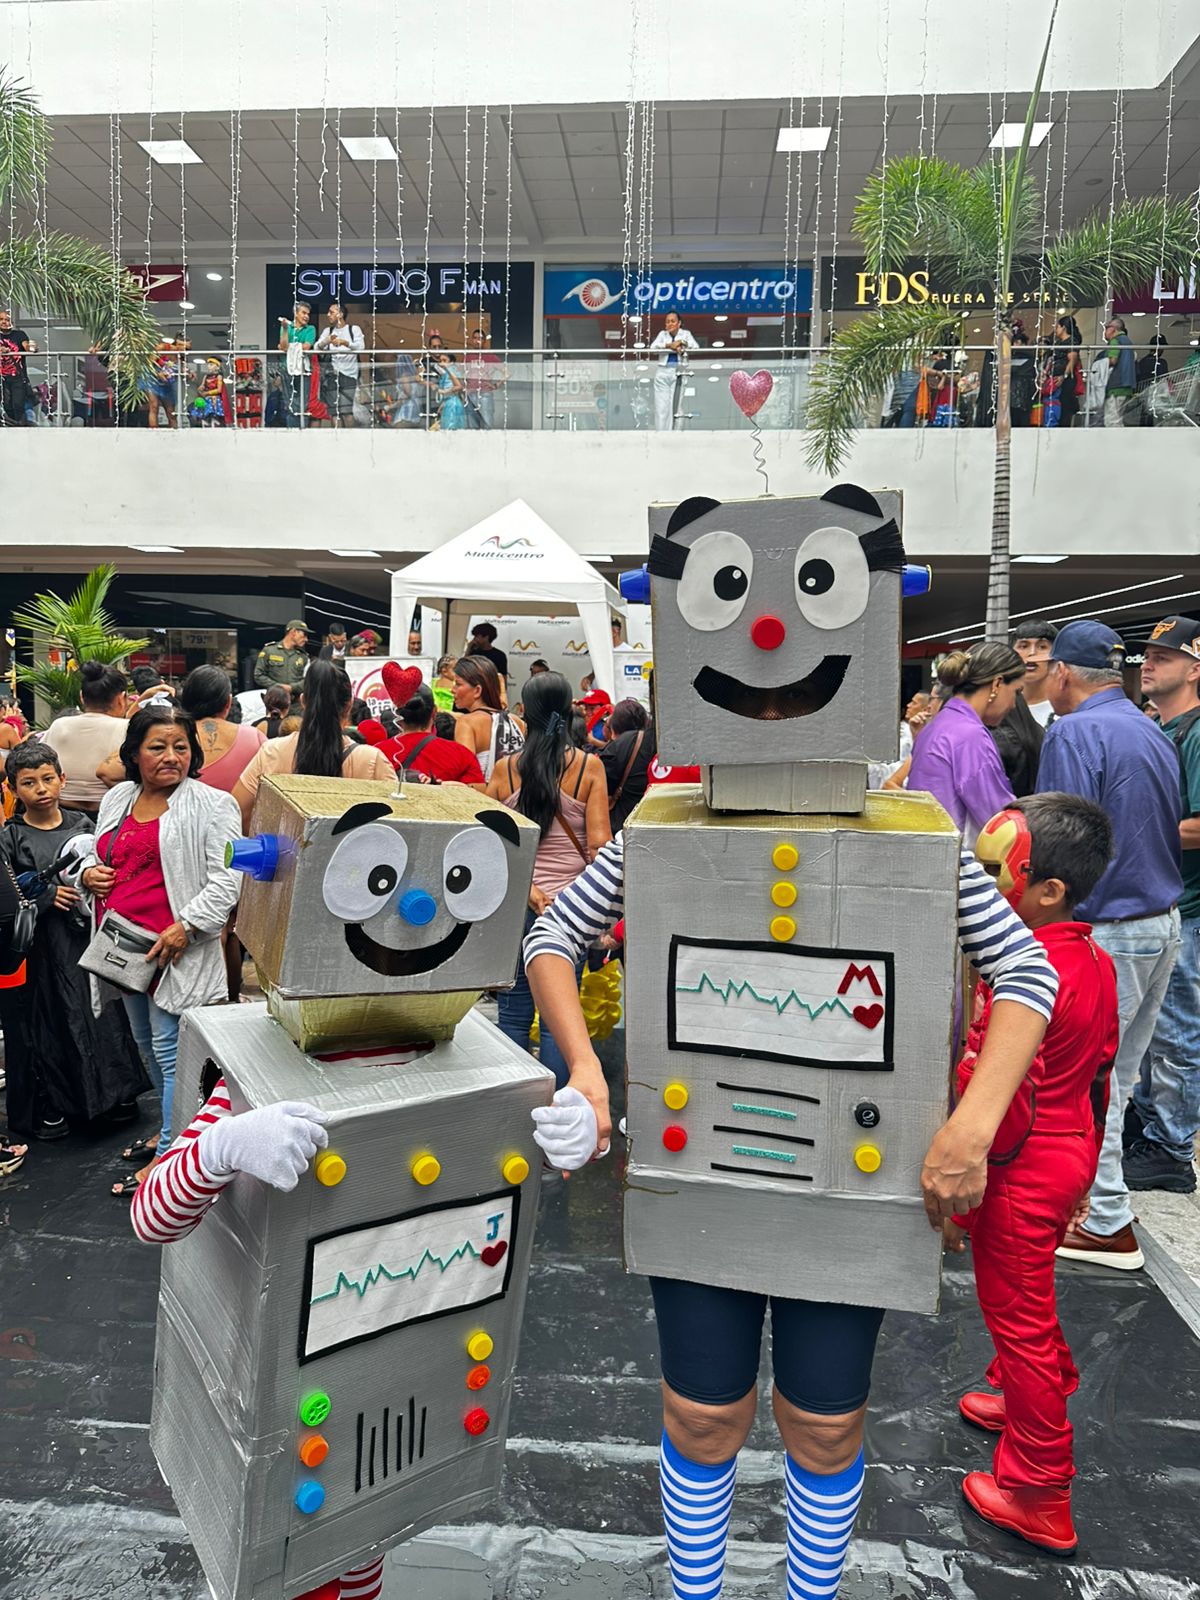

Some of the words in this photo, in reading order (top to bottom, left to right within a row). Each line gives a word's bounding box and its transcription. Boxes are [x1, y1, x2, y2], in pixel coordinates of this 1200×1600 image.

[297, 268, 431, 297] STUDIO
[440, 268, 462, 295] F
[464, 280, 502, 295] MAN
[633, 276, 796, 309] opticentro
[854, 271, 930, 305] FDS
[931, 293, 986, 304] FUERA
[464, 551, 545, 559] Multicentro
[625, 666, 641, 675] LA
[367, 698, 376, 706] la
[837, 962, 883, 997] M
[486, 1212, 504, 1241] J
